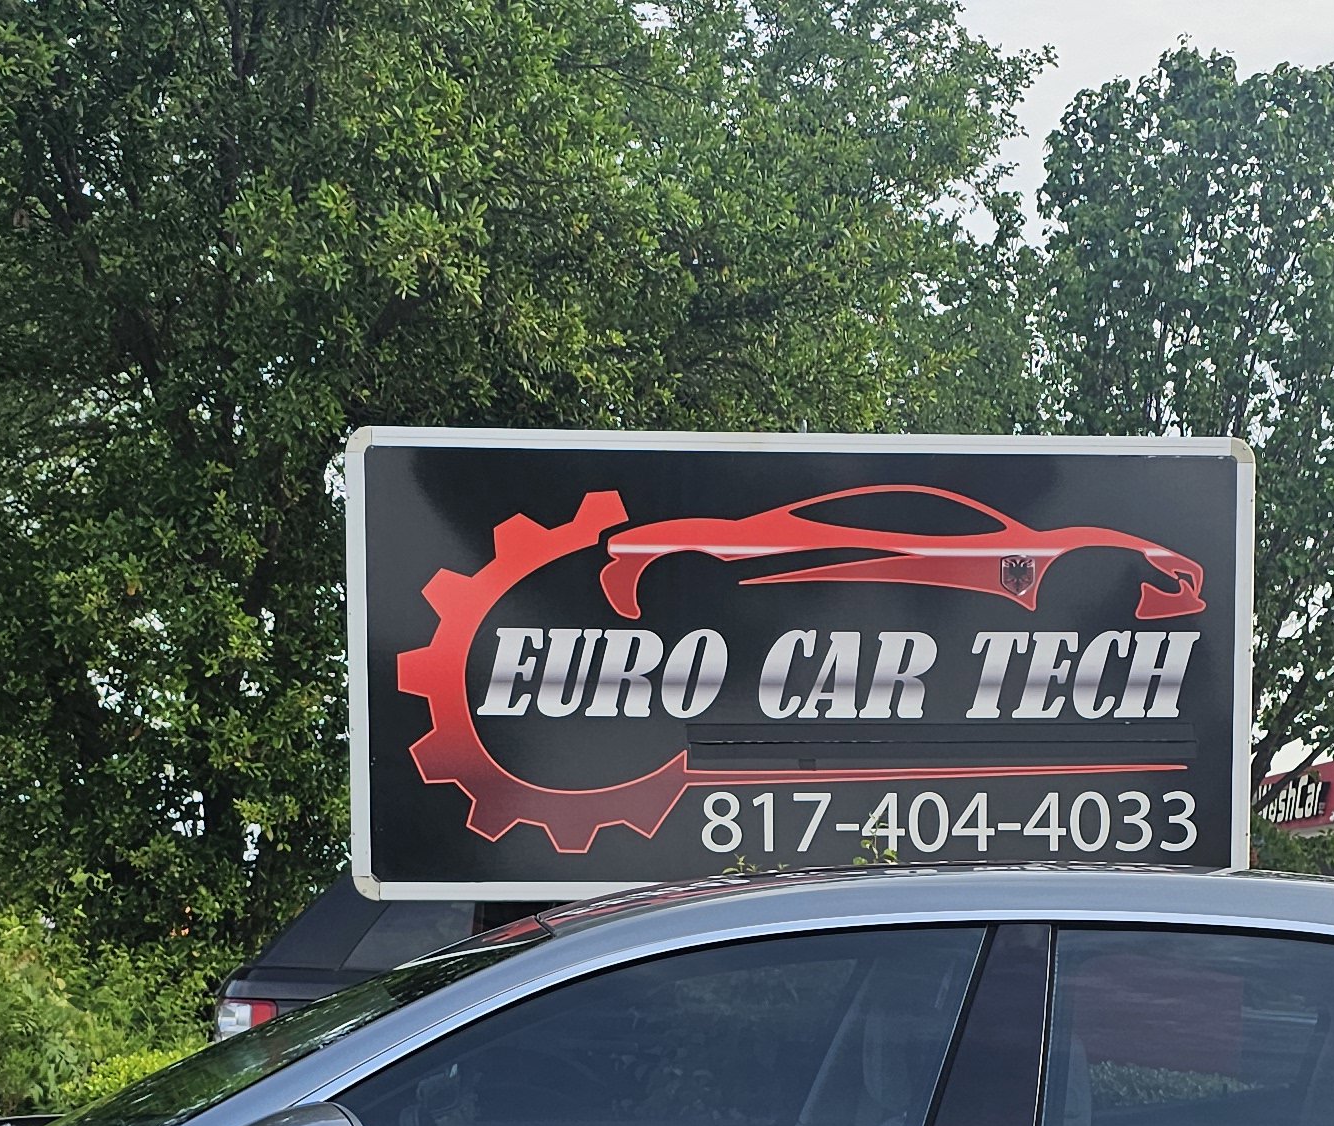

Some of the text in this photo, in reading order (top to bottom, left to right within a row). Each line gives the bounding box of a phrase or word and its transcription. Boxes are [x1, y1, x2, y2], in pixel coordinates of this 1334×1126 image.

[477, 627, 1201, 720] EURO CAR TECH
[699, 790, 1198, 853] 817-404-4033
